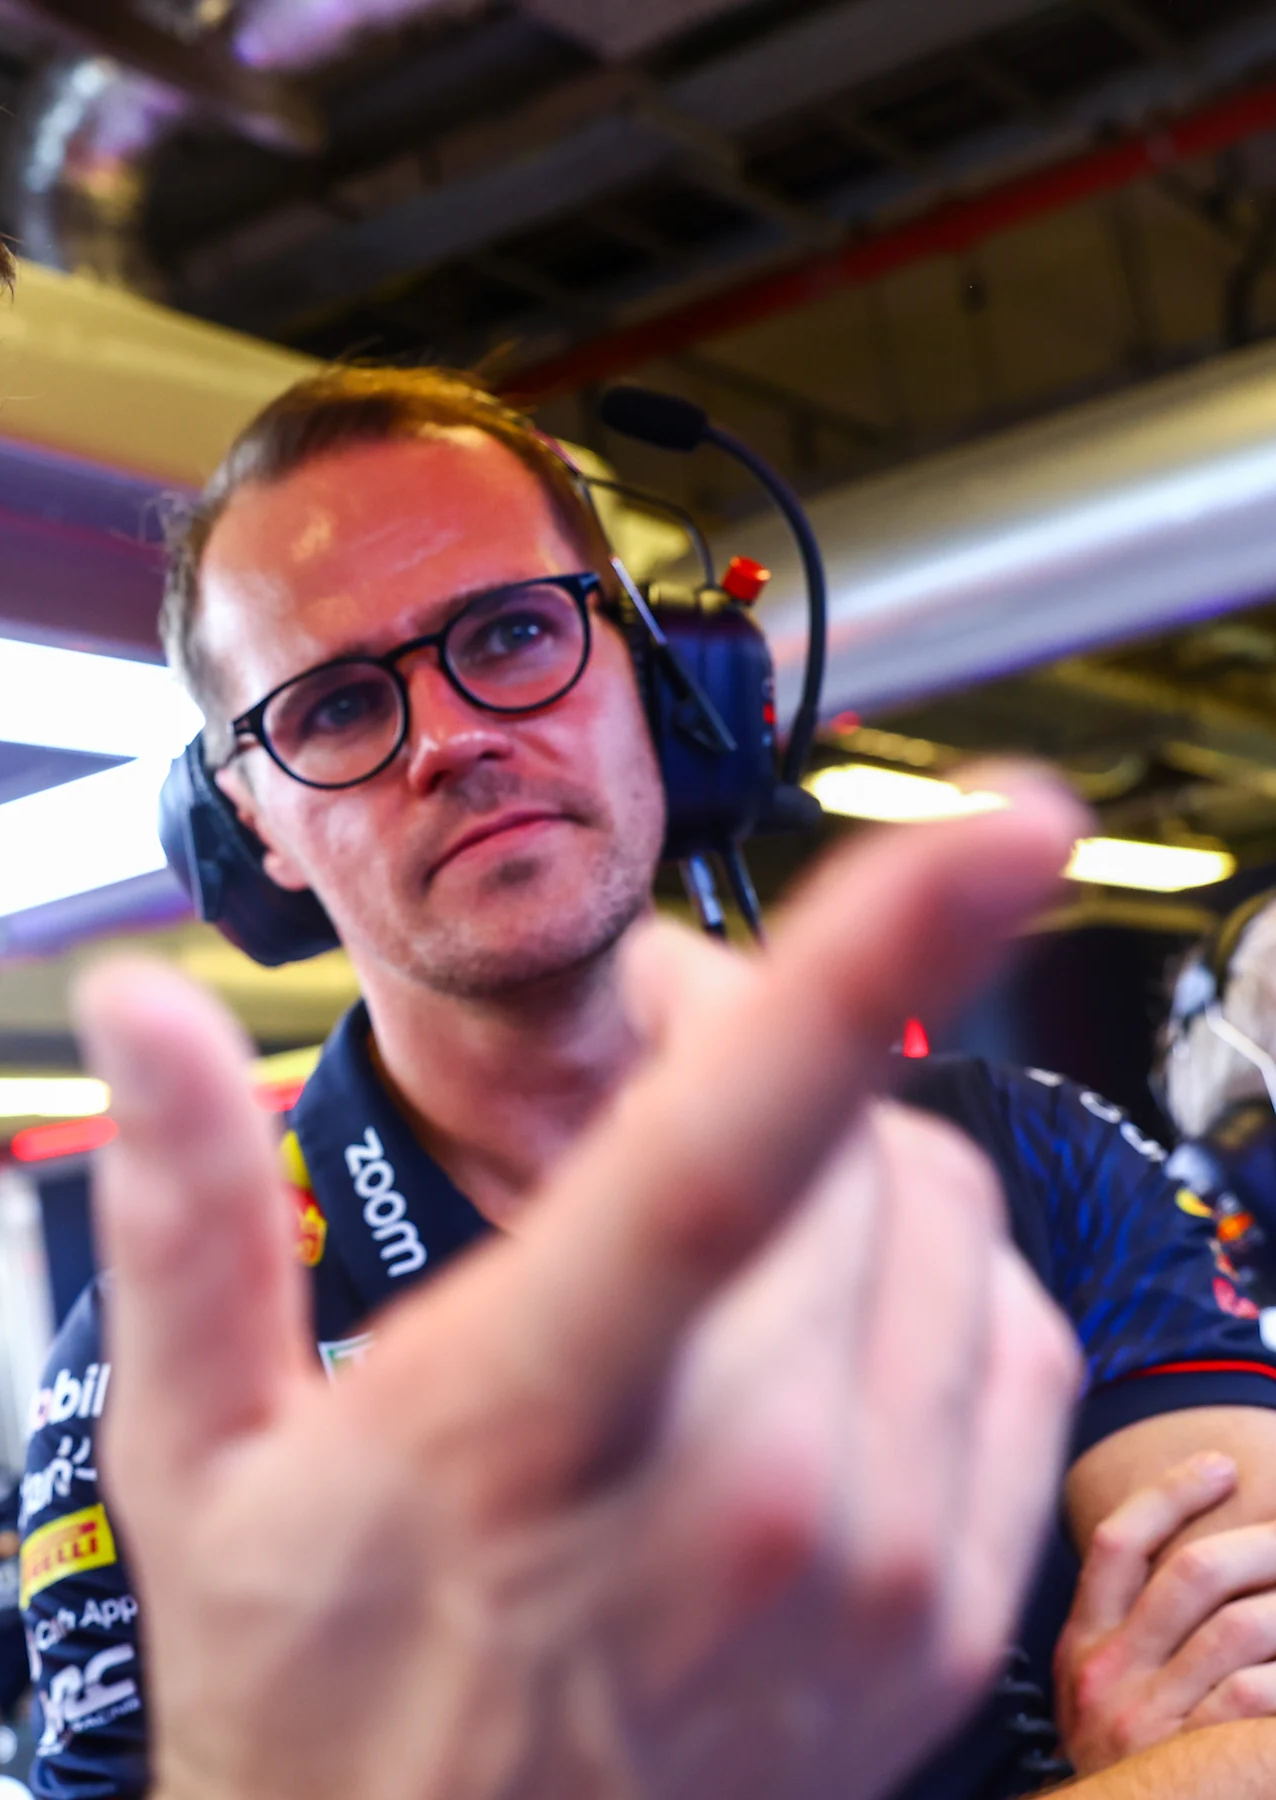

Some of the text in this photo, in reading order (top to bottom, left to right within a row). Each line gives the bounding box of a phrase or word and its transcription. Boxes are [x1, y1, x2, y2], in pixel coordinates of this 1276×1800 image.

[344, 1126, 427, 1278] zoom
[29, 1363, 112, 1430] obil
[79, 1595, 139, 1630] App
